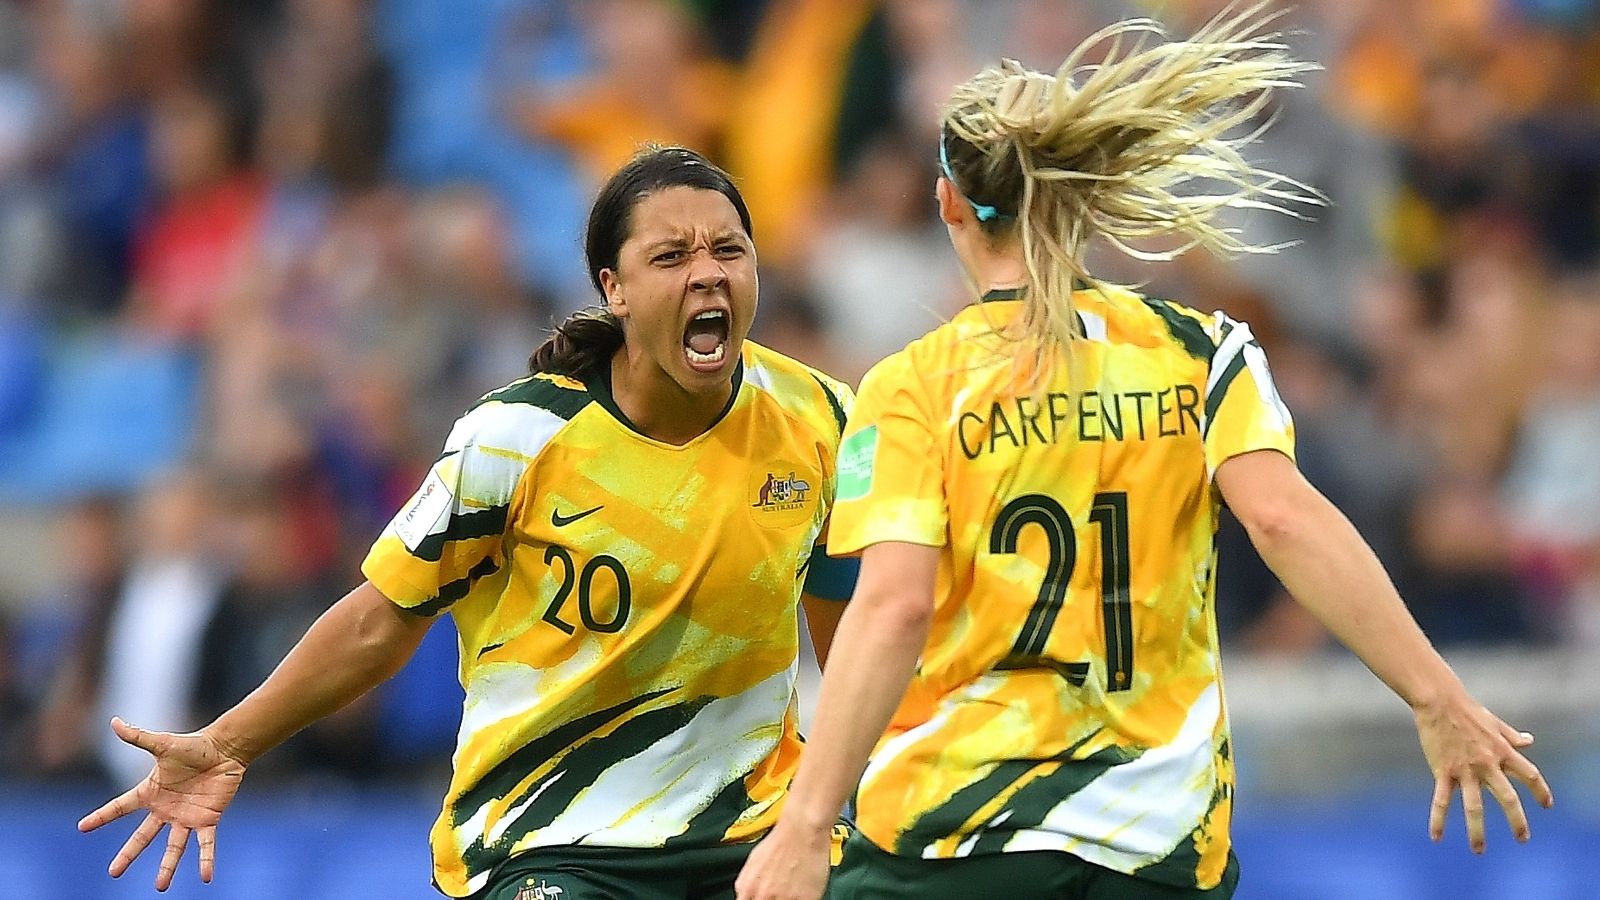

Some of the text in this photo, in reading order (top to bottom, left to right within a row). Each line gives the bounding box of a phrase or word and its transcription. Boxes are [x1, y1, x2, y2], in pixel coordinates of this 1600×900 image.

[958, 384, 1201, 460] CARPENTER
[542, 544, 631, 634] 20
[989, 491, 1133, 692] 21
